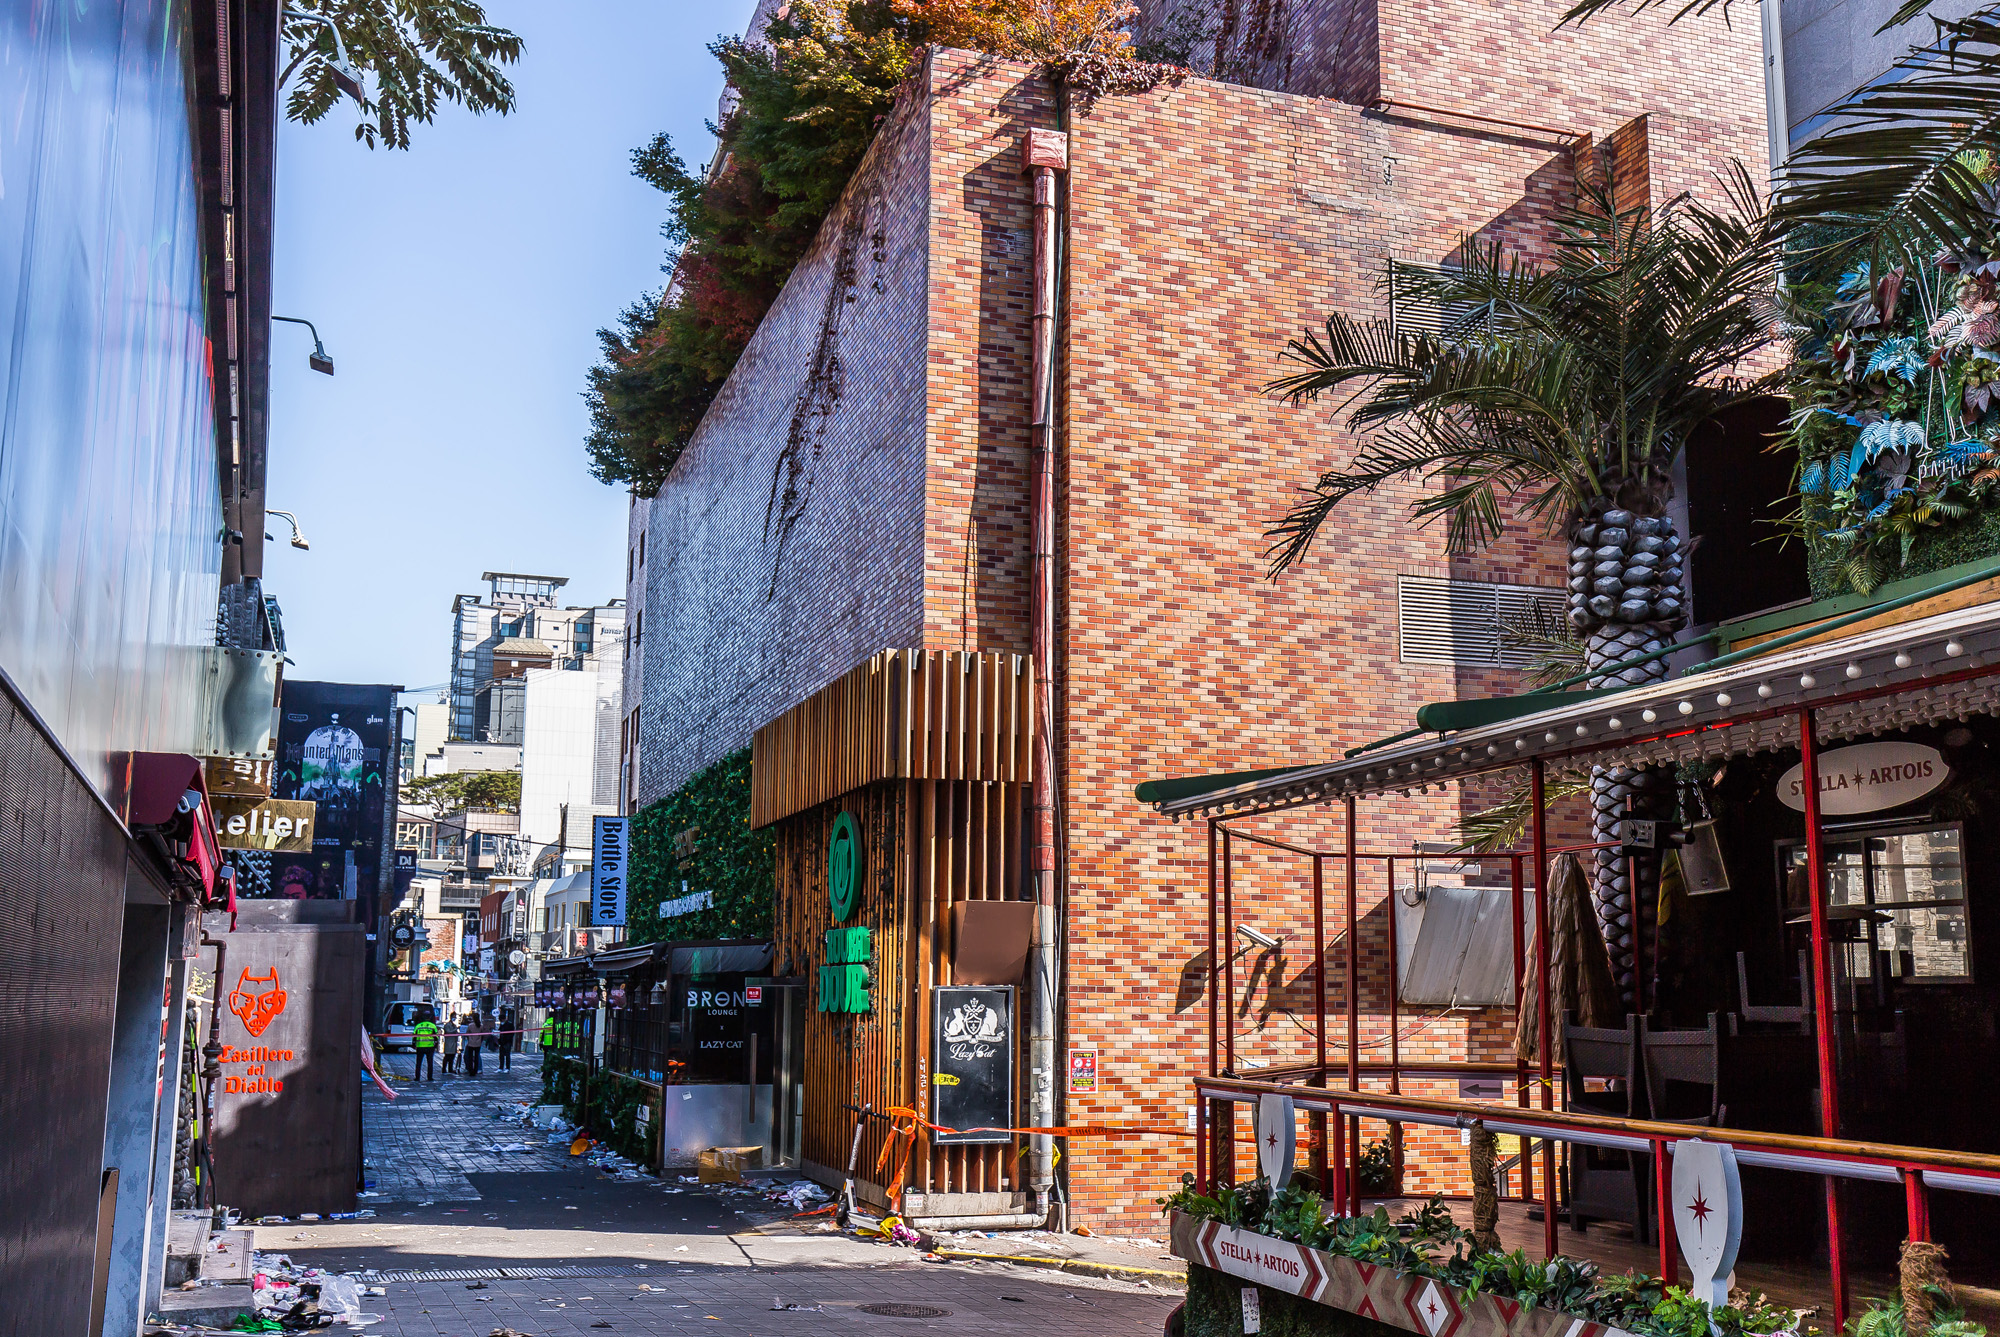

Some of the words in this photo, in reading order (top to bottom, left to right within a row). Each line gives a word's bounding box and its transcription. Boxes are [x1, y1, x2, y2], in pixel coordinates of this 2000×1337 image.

[1790, 773, 1849, 796] STLLA
[1868, 760, 1933, 785] ARTOIS
[600, 820, 623, 872] Bottle
[599, 876, 622, 919] Store
[818, 964, 869, 1014] DOUR
[687, 991, 760, 1007] BRON
[217, 1045, 294, 1063] Casillero
[700, 1041, 725, 1049] LAZY
[726, 1041, 744, 1049] CAT
[950, 1043, 976, 1061] Lazy
[247, 1064, 265, 1076] del
[224, 1075, 284, 1094] Diablo
[1220, 1240, 1253, 1264] STELLA
[1262, 1253, 1300, 1278] ARTOIS
